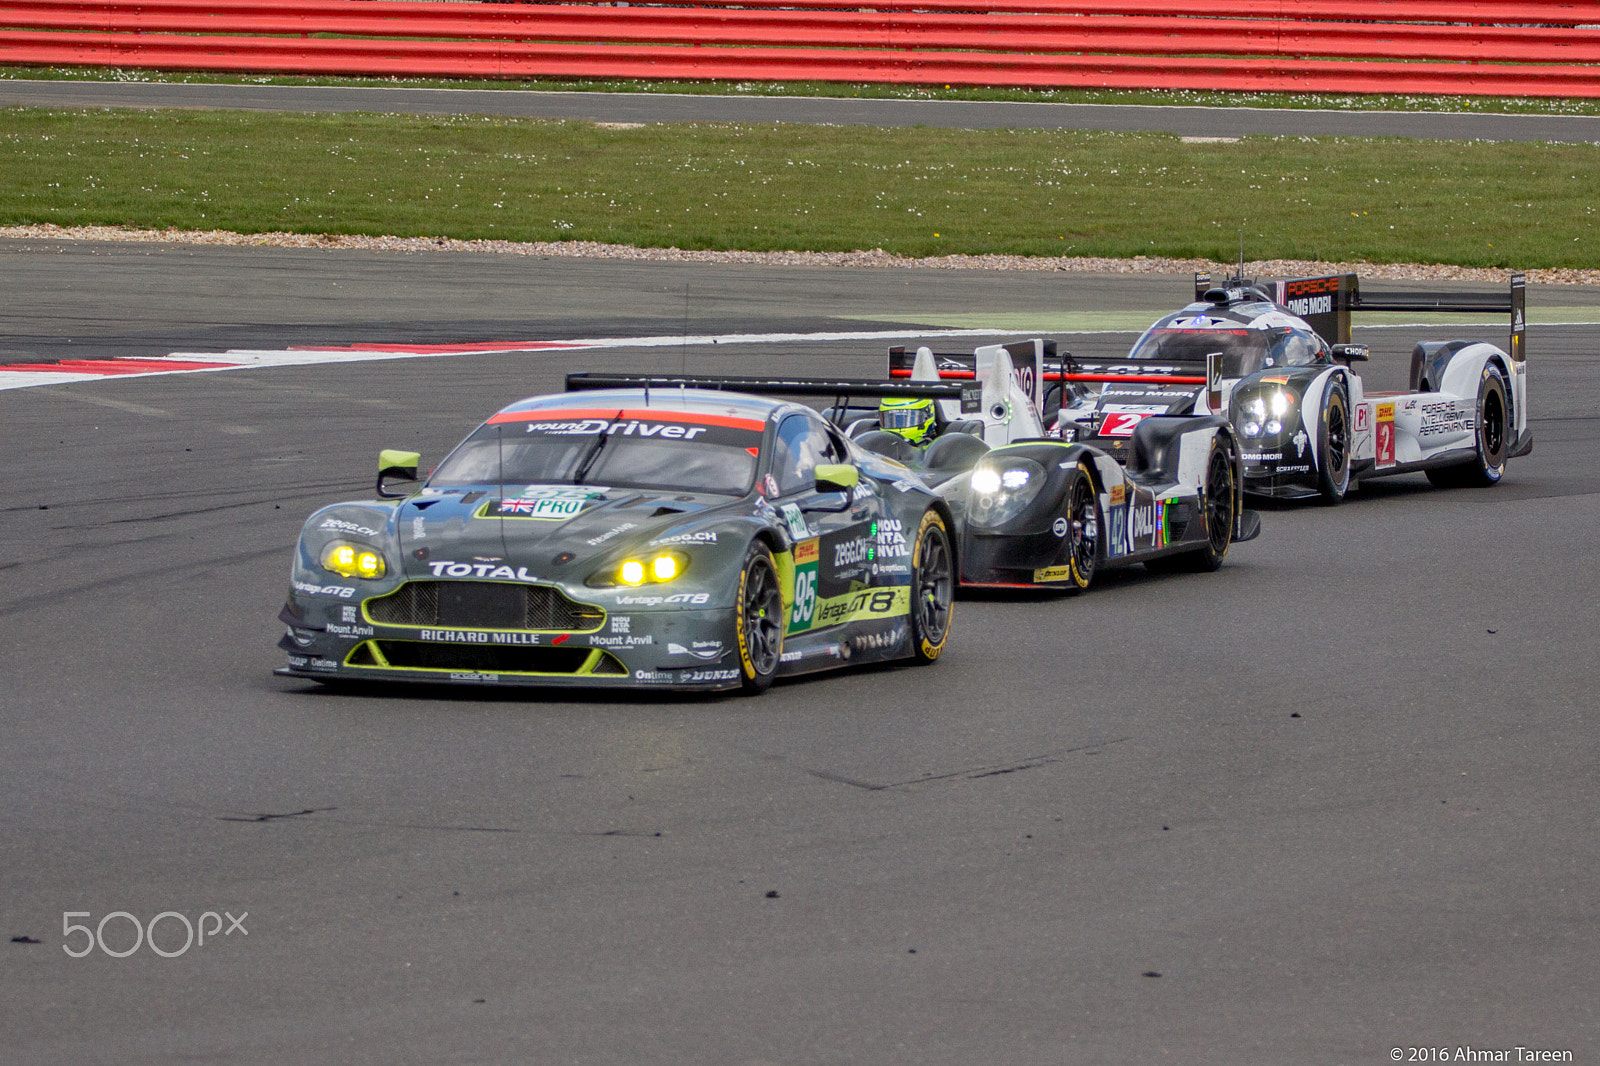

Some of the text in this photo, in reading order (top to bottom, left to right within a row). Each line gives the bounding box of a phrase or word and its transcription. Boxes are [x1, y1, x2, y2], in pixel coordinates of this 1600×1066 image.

[1288, 277, 1338, 296] PORSCHE
[1288, 295, 1331, 316] DMG MORI
[1421, 400, 1456, 414] PORSCHE
[1110, 414, 1137, 434] 2
[1358, 408, 1367, 427] P1
[1380, 424, 1390, 460] 2
[537, 500, 579, 514] PRO
[877, 531, 906, 545] NTA
[1111, 507, 1124, 555] 42
[877, 544, 910, 557] NVIL
[429, 560, 538, 582] TOTAL
[615, 592, 710, 606] Vantage GT8
[792, 570, 817, 623] 95
[847, 591, 896, 613] GT8
[327, 623, 374, 636] Mount Anvil
[421, 629, 540, 644] RICHARD MILLE
[589, 635, 653, 645] Mount Anvil
[311, 657, 338, 668] Ontime
[635, 669, 673, 680] Ontime
[692, 669, 740, 681] DUNLOP
